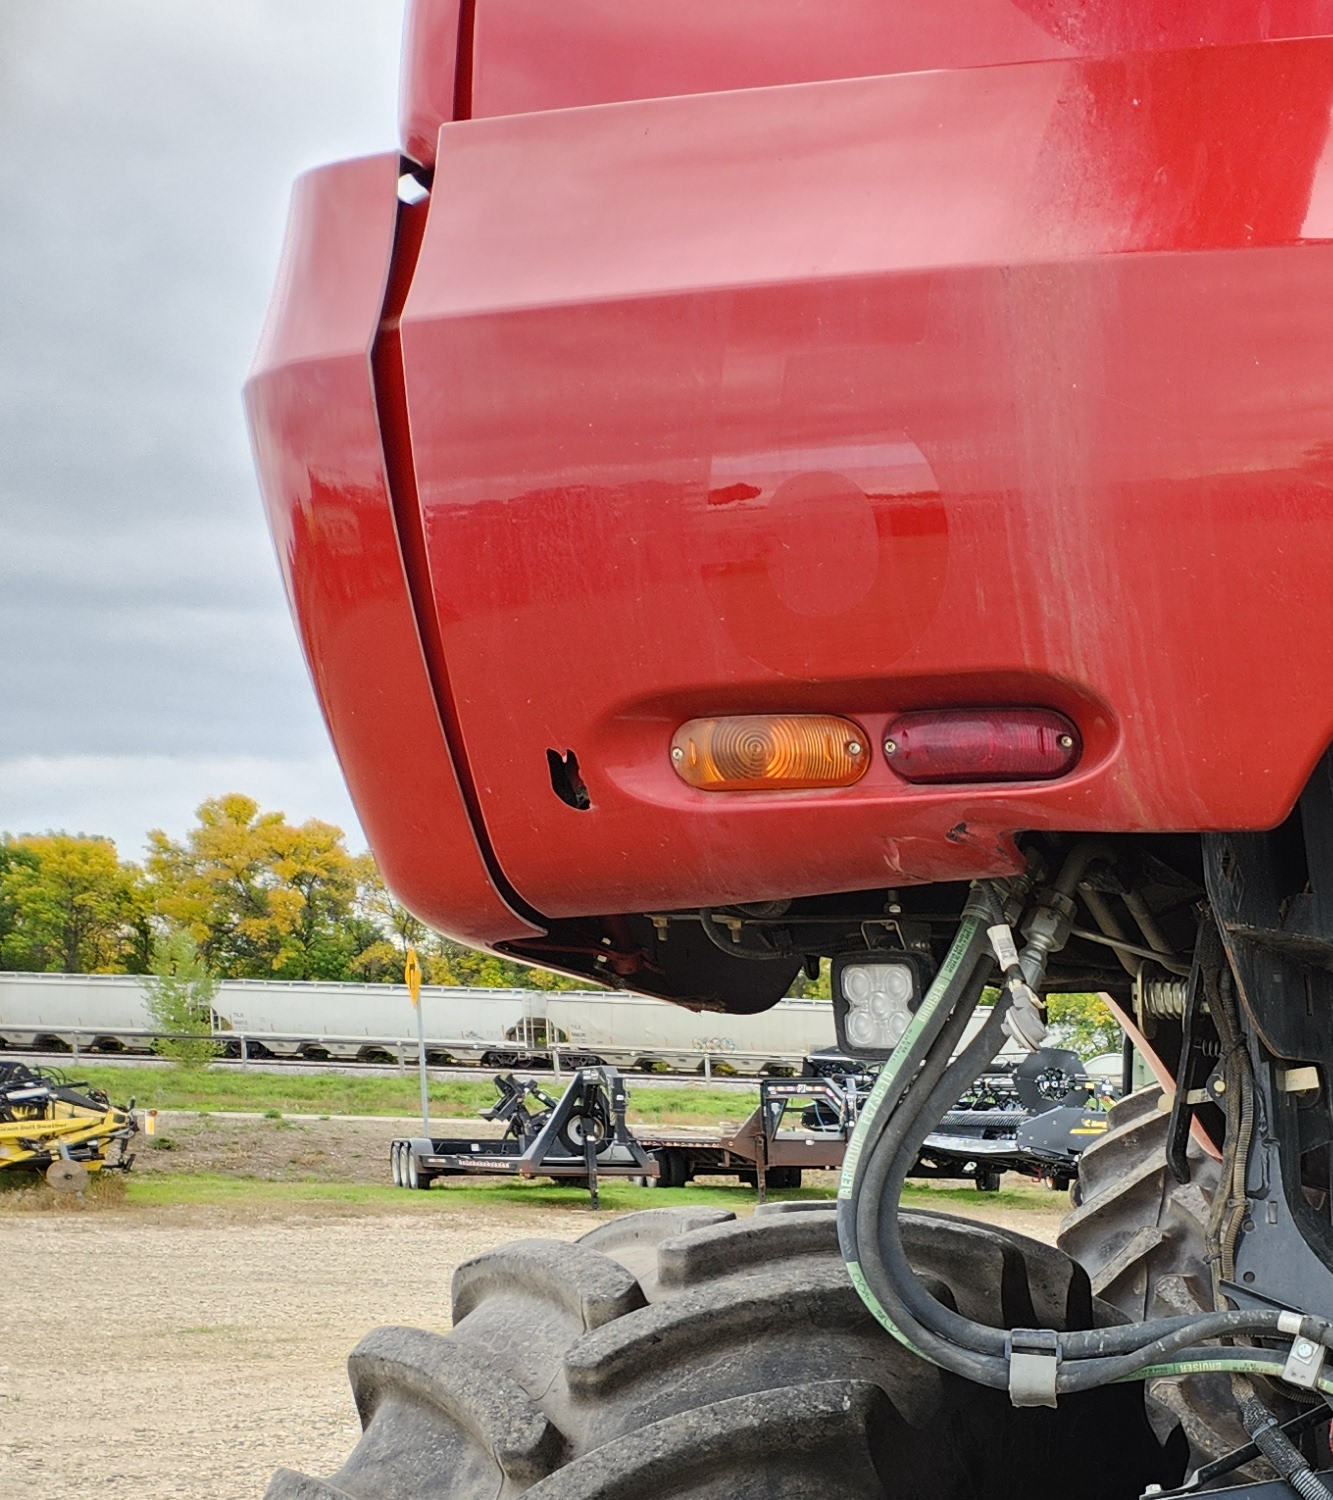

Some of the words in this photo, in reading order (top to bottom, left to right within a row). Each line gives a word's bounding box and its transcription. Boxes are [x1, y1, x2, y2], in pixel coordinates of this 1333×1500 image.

[840, 1131, 863, 1196] AEROQUIP
[860, 1070, 894, 1126] FC735-10
[916, 982, 946, 1023] BRUISER
[1179, 1361, 1222, 1372] BRUISER
